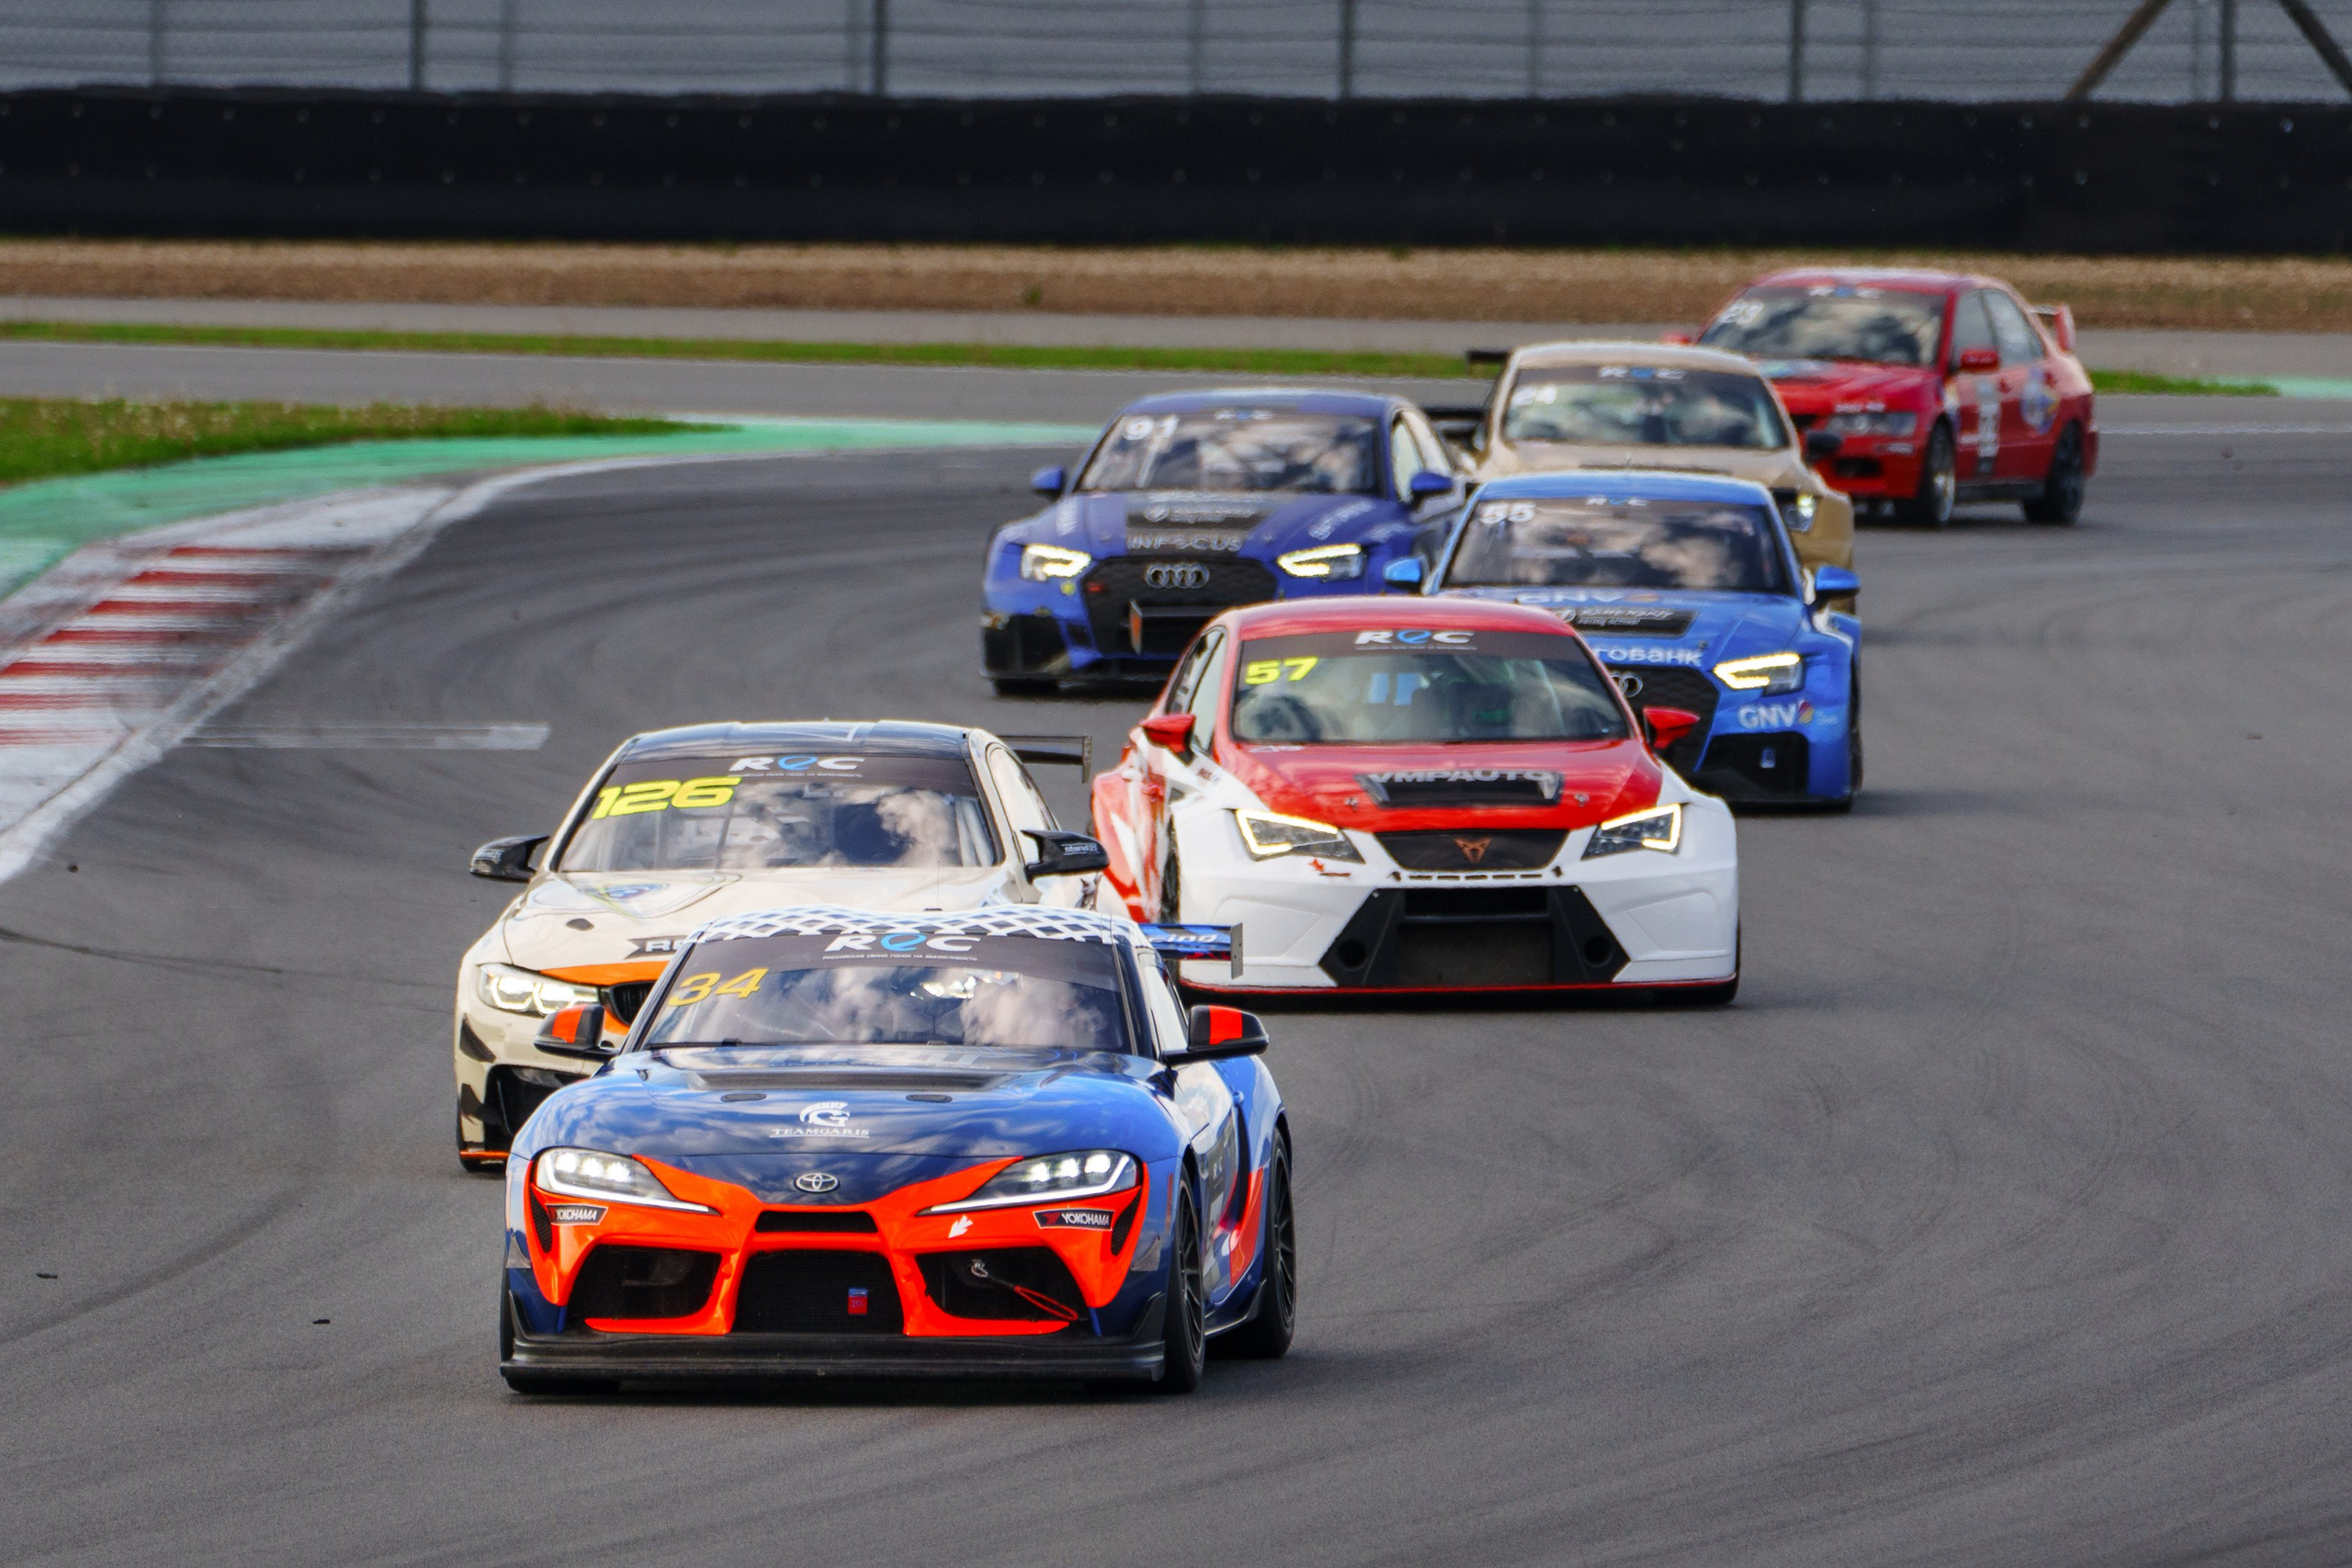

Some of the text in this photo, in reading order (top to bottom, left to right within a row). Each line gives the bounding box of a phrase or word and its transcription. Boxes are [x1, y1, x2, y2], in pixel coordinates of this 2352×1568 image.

[1124, 414, 1180, 440] 91
[1245, 656, 1318, 685] 57
[1739, 704, 1796, 728] GNV
[592, 776, 742, 819] 126
[668, 966, 769, 1007] 34
[772, 1127, 870, 1135] TEAMGARIS
[556, 1209, 598, 1221] YOKOHAMA
[1061, 1212, 1110, 1226] YOKOHAMA
